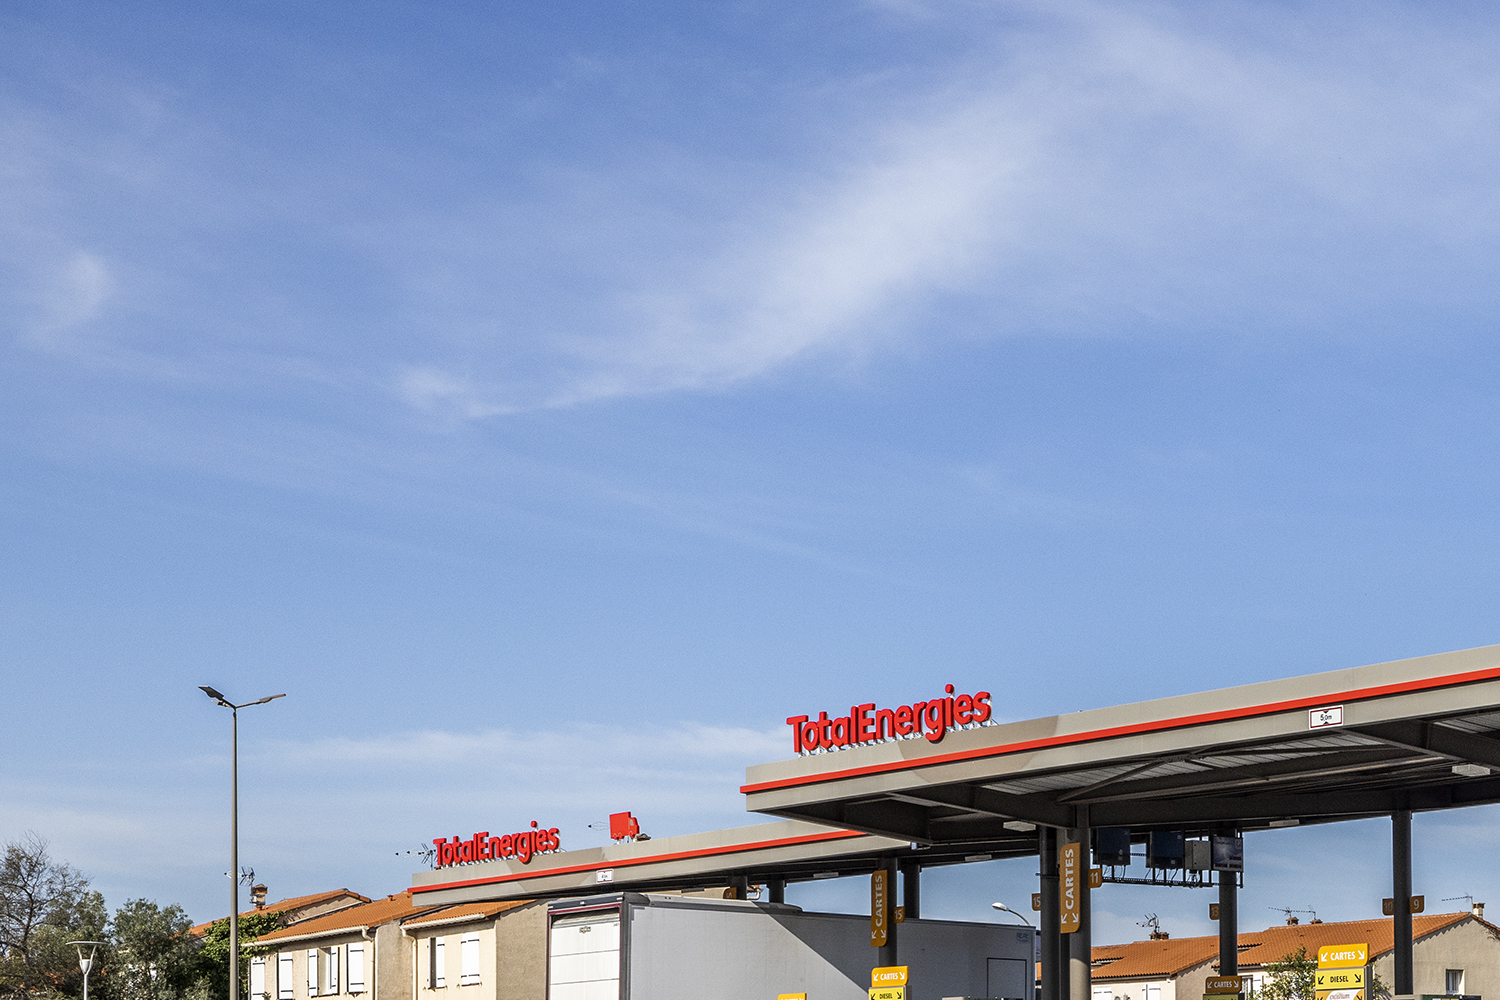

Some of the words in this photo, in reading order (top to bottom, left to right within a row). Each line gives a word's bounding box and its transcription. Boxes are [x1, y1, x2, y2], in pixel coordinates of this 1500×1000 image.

[787, 684, 992, 755] TotalEnergies
[433, 821, 560, 865] TotalEnergies
[1065, 849, 1074, 910] CARTES
[1090, 872, 1099, 884] 11
[875, 874, 883, 927] CARTES
[1414, 899, 1419, 910] 9
[1384, 902, 1393, 912] 10
[895, 909, 902, 920] 15
[1330, 951, 1355, 961] CARTES
[880, 972, 898, 980] CARTES
